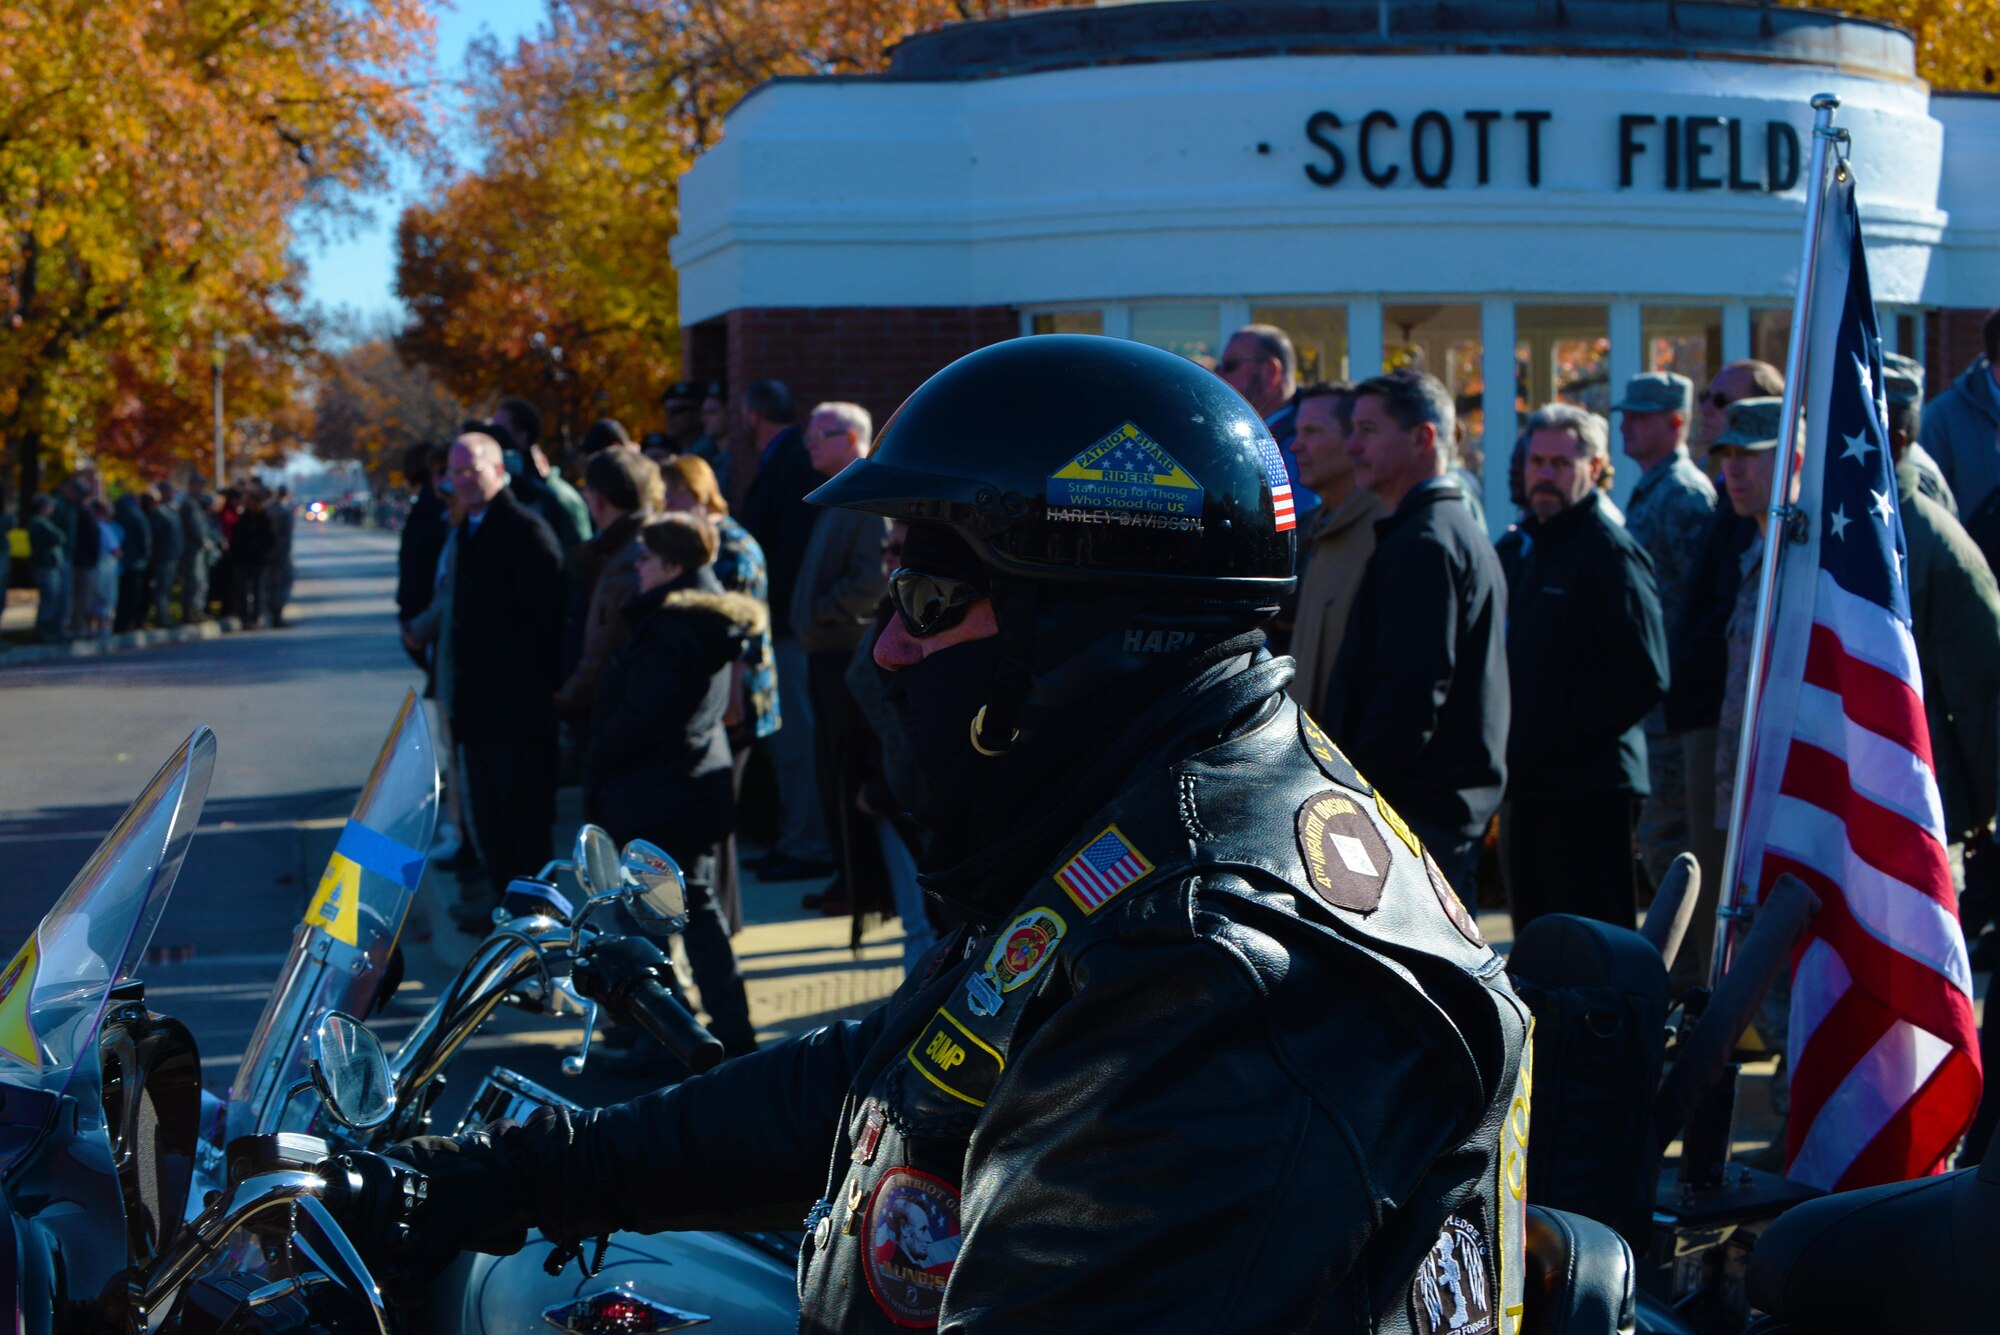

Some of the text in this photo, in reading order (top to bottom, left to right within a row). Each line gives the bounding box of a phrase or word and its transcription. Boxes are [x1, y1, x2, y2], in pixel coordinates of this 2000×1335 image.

[1303, 110, 1800, 192] SCOTT FIELD
[1076, 427, 1176, 472] PATRIOT GUARD
[1068, 482, 1188, 501] Standing for Those
[1101, 470, 1155, 485] RIDERS
[1070, 494, 1185, 513] Who Stood for US
[1305, 798, 1358, 889] 4TH INFANTRY DIVISION
[925, 1030, 966, 1071] BUMP
[1461, 1315, 1491, 1335] FORGET
